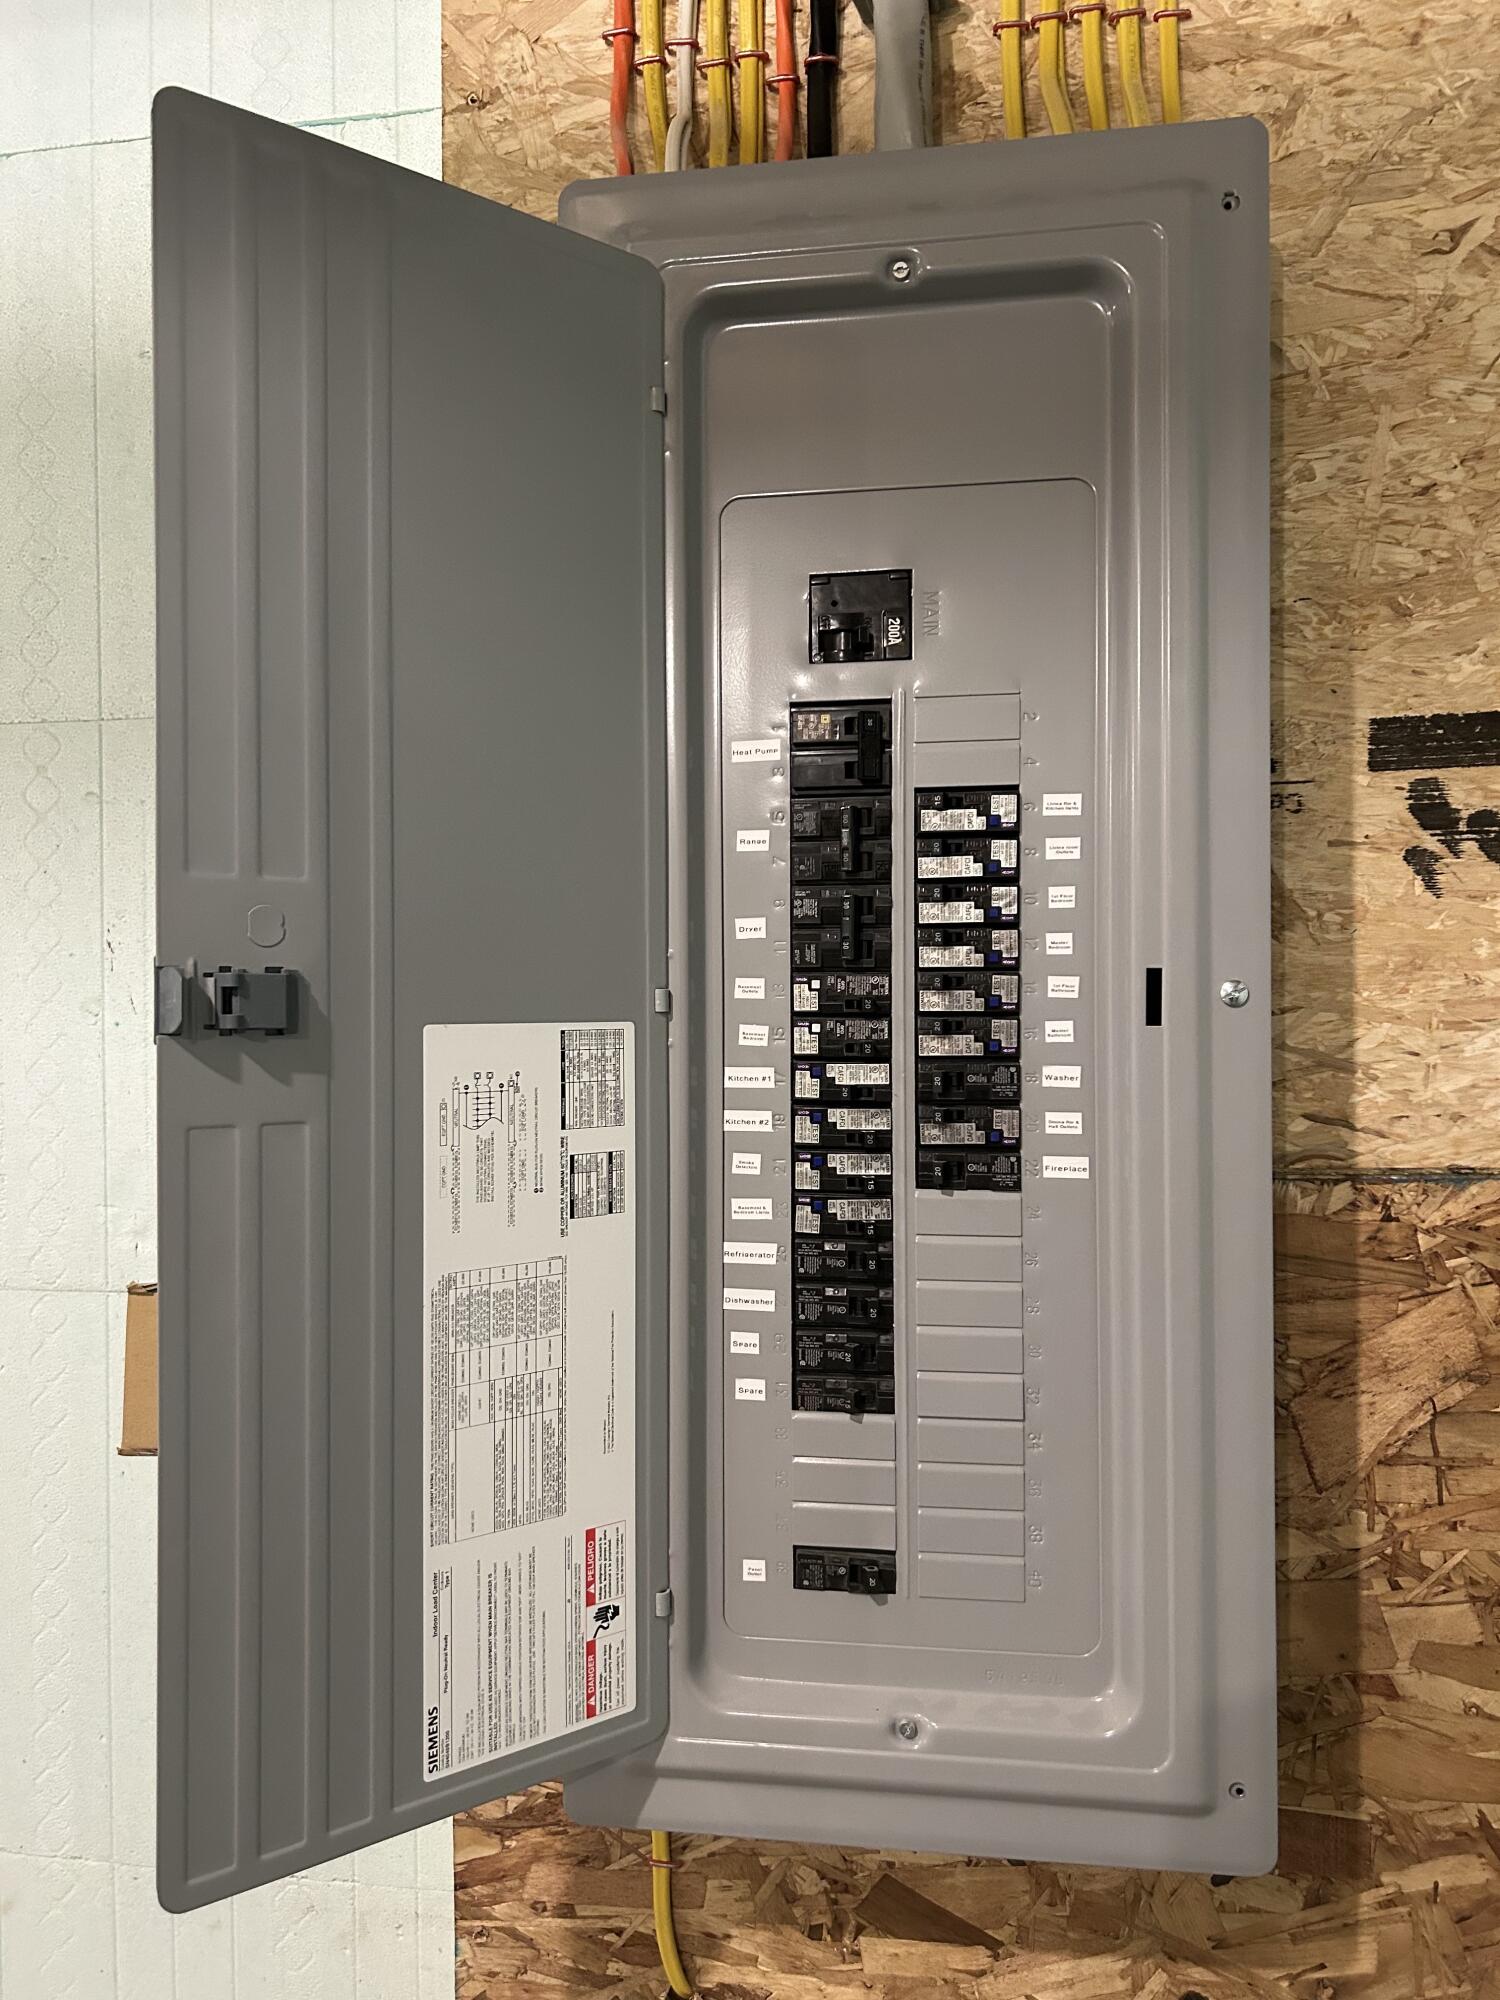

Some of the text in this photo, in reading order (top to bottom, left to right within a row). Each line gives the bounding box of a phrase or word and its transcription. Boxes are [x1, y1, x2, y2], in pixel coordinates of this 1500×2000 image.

[922, 591, 941, 636] MAIN
[887, 617, 902, 645] 200A
[1024, 757, 1040, 766] 4
[934, 795, 942, 805] 15
[933, 842, 940, 852] 20
[933, 887, 941, 898] 20
[1024, 892, 1040, 905] 10
[842, 900, 850, 910] 30
[965, 903, 973, 921] CAFCI
[934, 932, 942, 942] 20
[992, 931, 1000, 949] TEST
[774, 941, 787, 953] 11
[842, 941, 850, 950] 30
[965, 948, 973, 966] CAFCI
[934, 977, 941, 987] 20
[773, 984, 785, 999] 13
[864, 999, 872, 1009] 20
[965, 991, 973, 1010] CAFCI
[934, 1021, 941, 1032] 20
[992, 1020, 1000, 1038] TEST
[772, 1027, 786, 1045] 15
[864, 1043, 872, 1054] 20
[934, 1077, 941, 1087] 20
[1044, 1074, 1079, 1082] Washer
[811, 1079, 819, 1097] TEST
[842, 1087, 848, 1097] 20
[934, 1112, 942, 1122] 20
[966, 1124, 974, 1143] CAFCI
[866, 1134, 874, 1145] 20
[773, 1159, 787, 1176] 21
[934, 1166, 942, 1176] 20
[1045, 1165, 1088, 1173] Fireplace
[867, 1180, 875, 1190] 15
[560, 1197, 565, 1205] OR
[839, 1201, 847, 1219] CAFCI
[1027, 1206, 1041, 1221] 24
[812, 1215, 820, 1233] TEST
[867, 1224, 874, 1235] 15
[724, 1250, 775, 1259] Refrigerator
[1025, 1252, 1039, 1268] 26
[868, 1259, 876, 1270] 20
[725, 1296, 773, 1305] Dishwasher
[869, 1308, 877, 1318] 20
[732, 1340, 758, 1348] Spare
[844, 1352, 852, 1362] 20
[738, 1387, 763, 1395] Spare
[1028, 1432, 1043, 1452] 34
[1028, 1479, 1042, 1498] 36
[1029, 1525, 1043, 1544] 38
[587, 1540, 595, 1582] PELIGRO
[427, 1706, 439, 1774] SIEMENS
